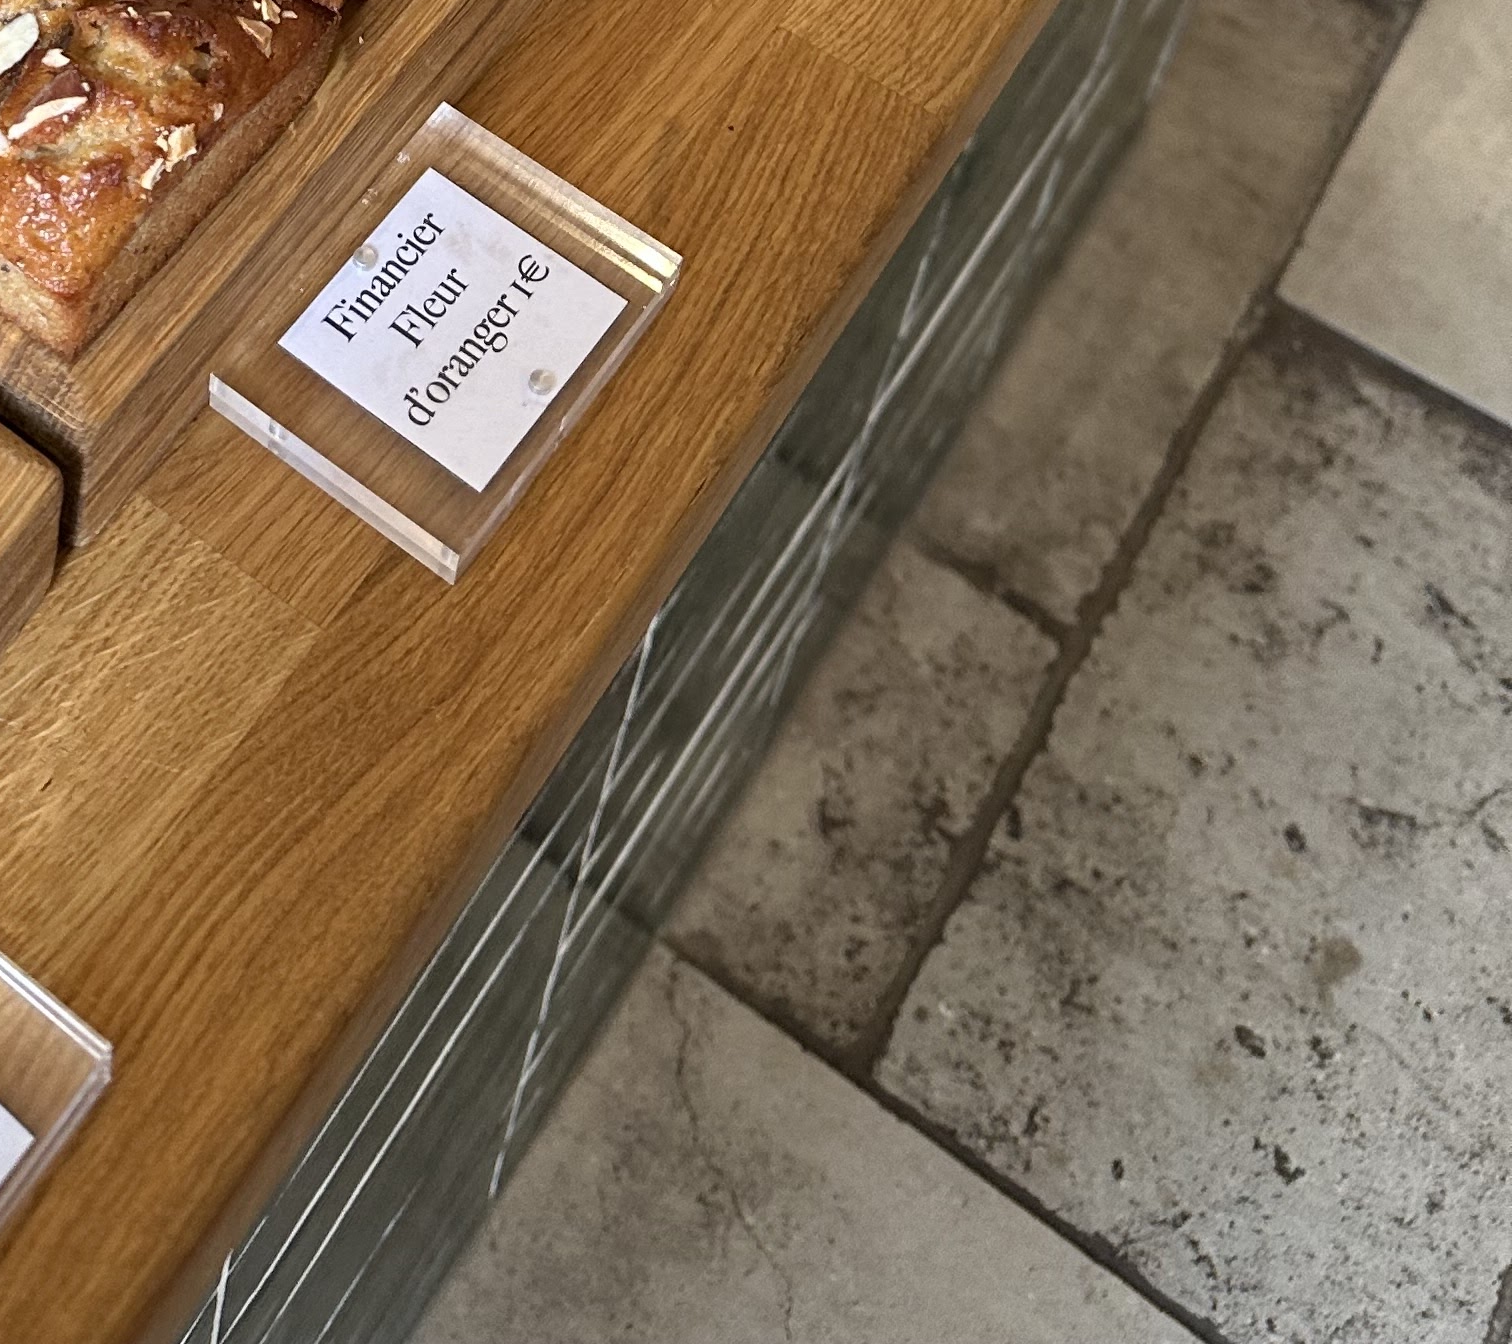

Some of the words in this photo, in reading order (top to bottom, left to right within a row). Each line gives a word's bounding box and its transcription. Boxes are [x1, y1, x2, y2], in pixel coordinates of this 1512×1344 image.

[321, 211, 447, 343] Financier
[388, 267, 470, 350] Fleur
[403, 292, 521, 428] d'oranger
